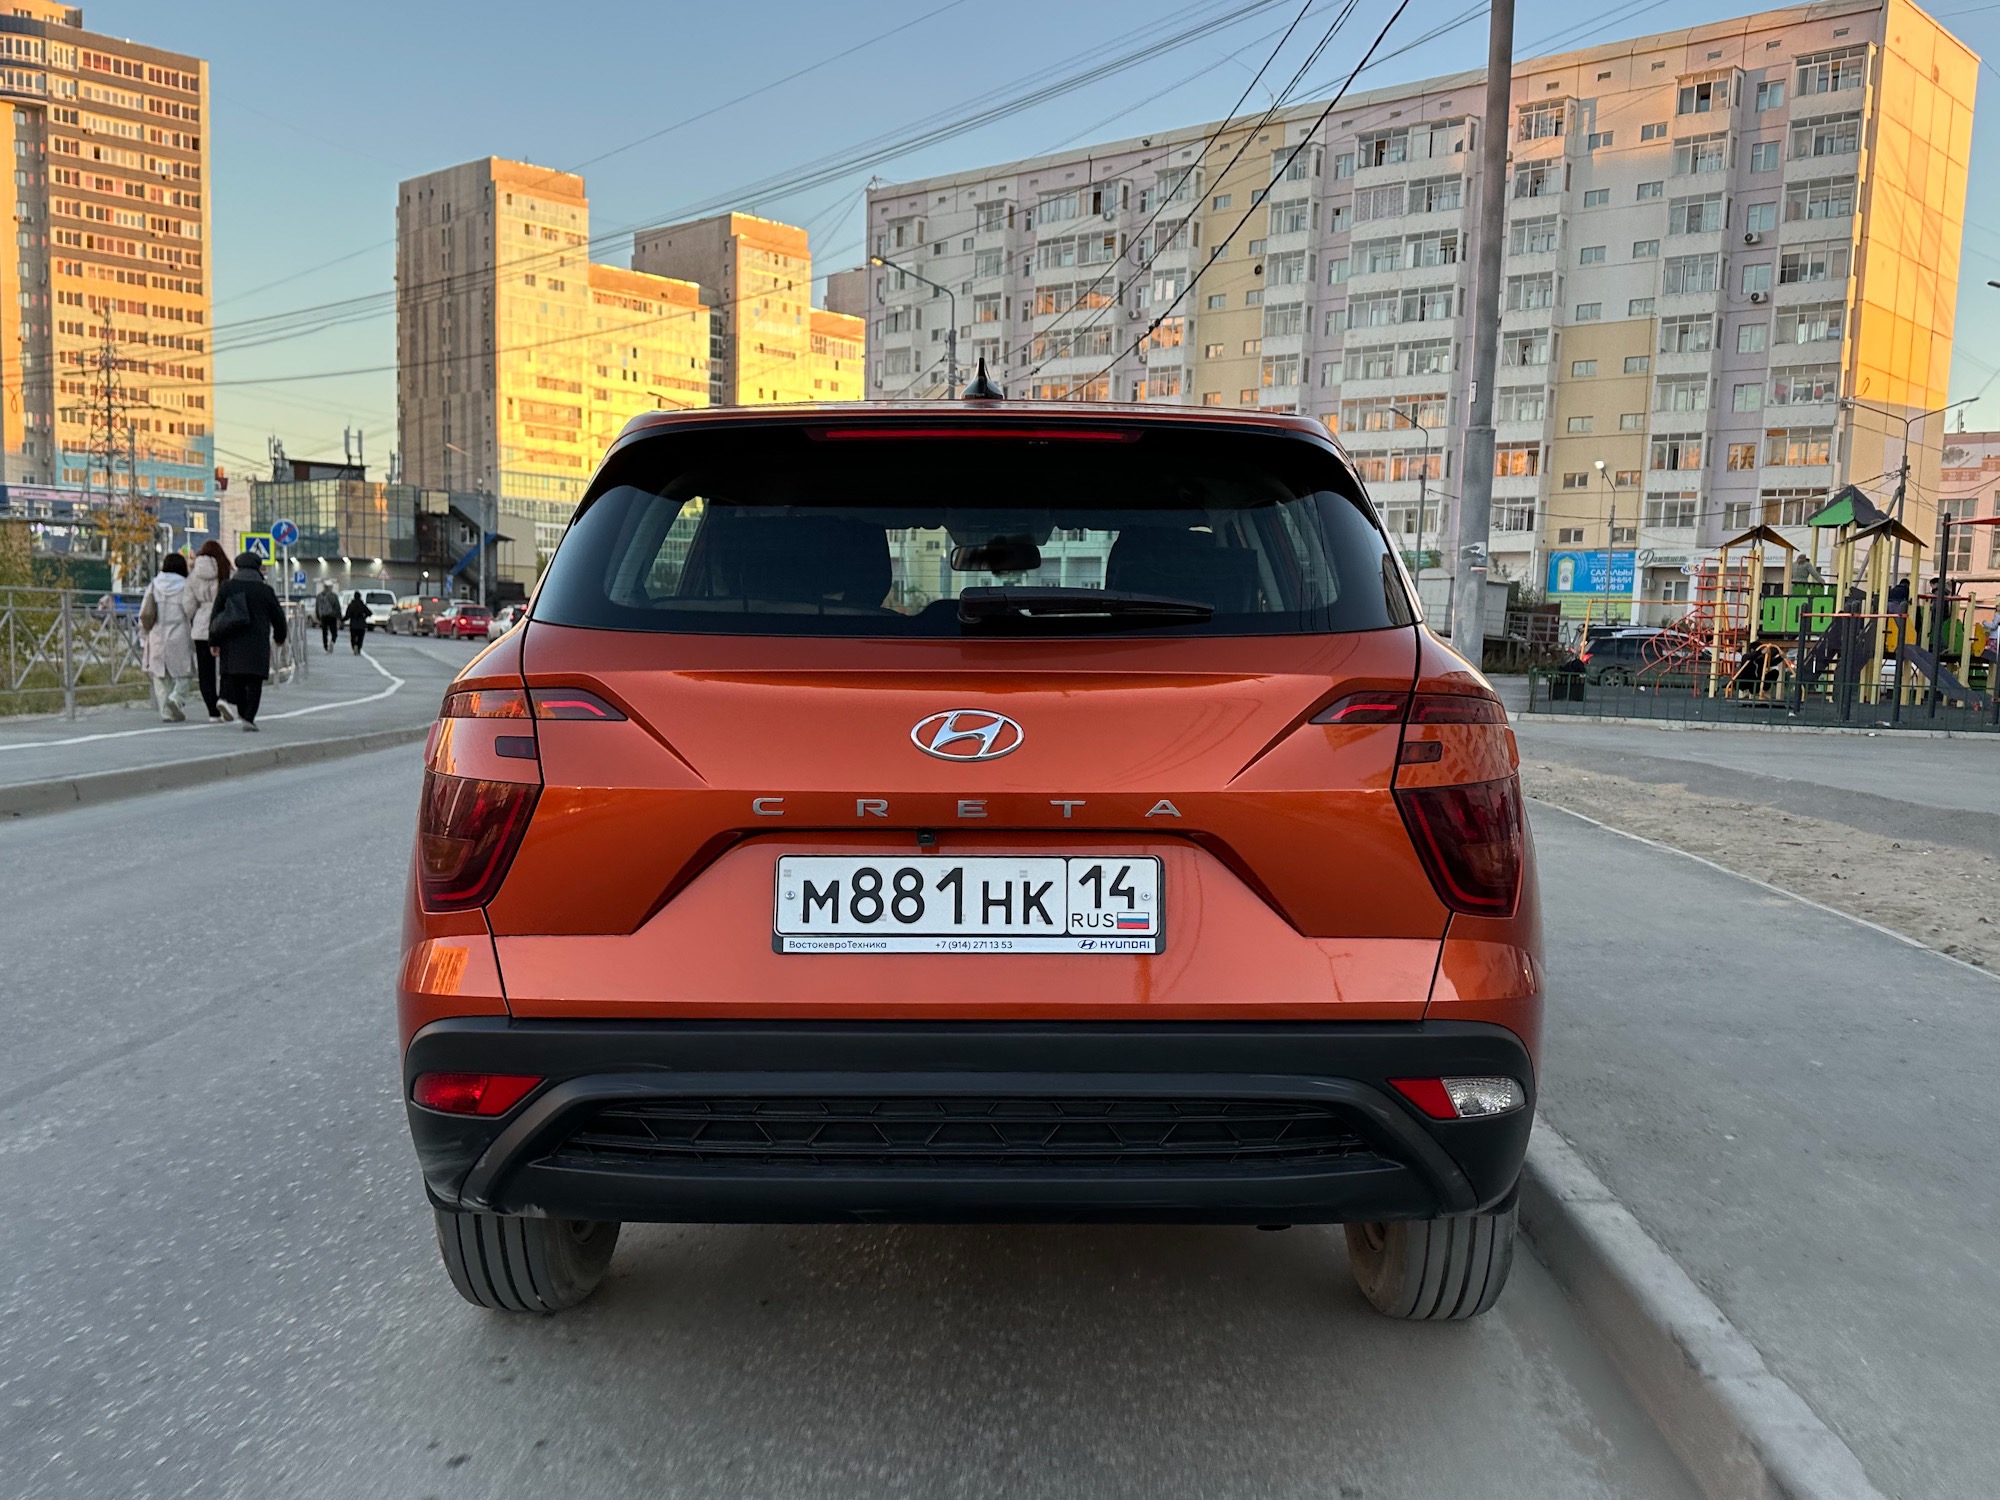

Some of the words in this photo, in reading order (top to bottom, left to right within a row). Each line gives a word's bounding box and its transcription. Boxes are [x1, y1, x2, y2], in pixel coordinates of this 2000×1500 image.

[752, 798, 1182, 818] CRETA
[1079, 866, 1135, 909] 14
[1071, 913, 1115, 928] RUS
[788, 940, 887, 950] ВостокевроТехника
[935, 941, 947, 949] +7
[948, 940, 971, 951] (914)
[1001, 941, 1013, 949] 53
[1100, 941, 1150, 949] HYUNDAI
